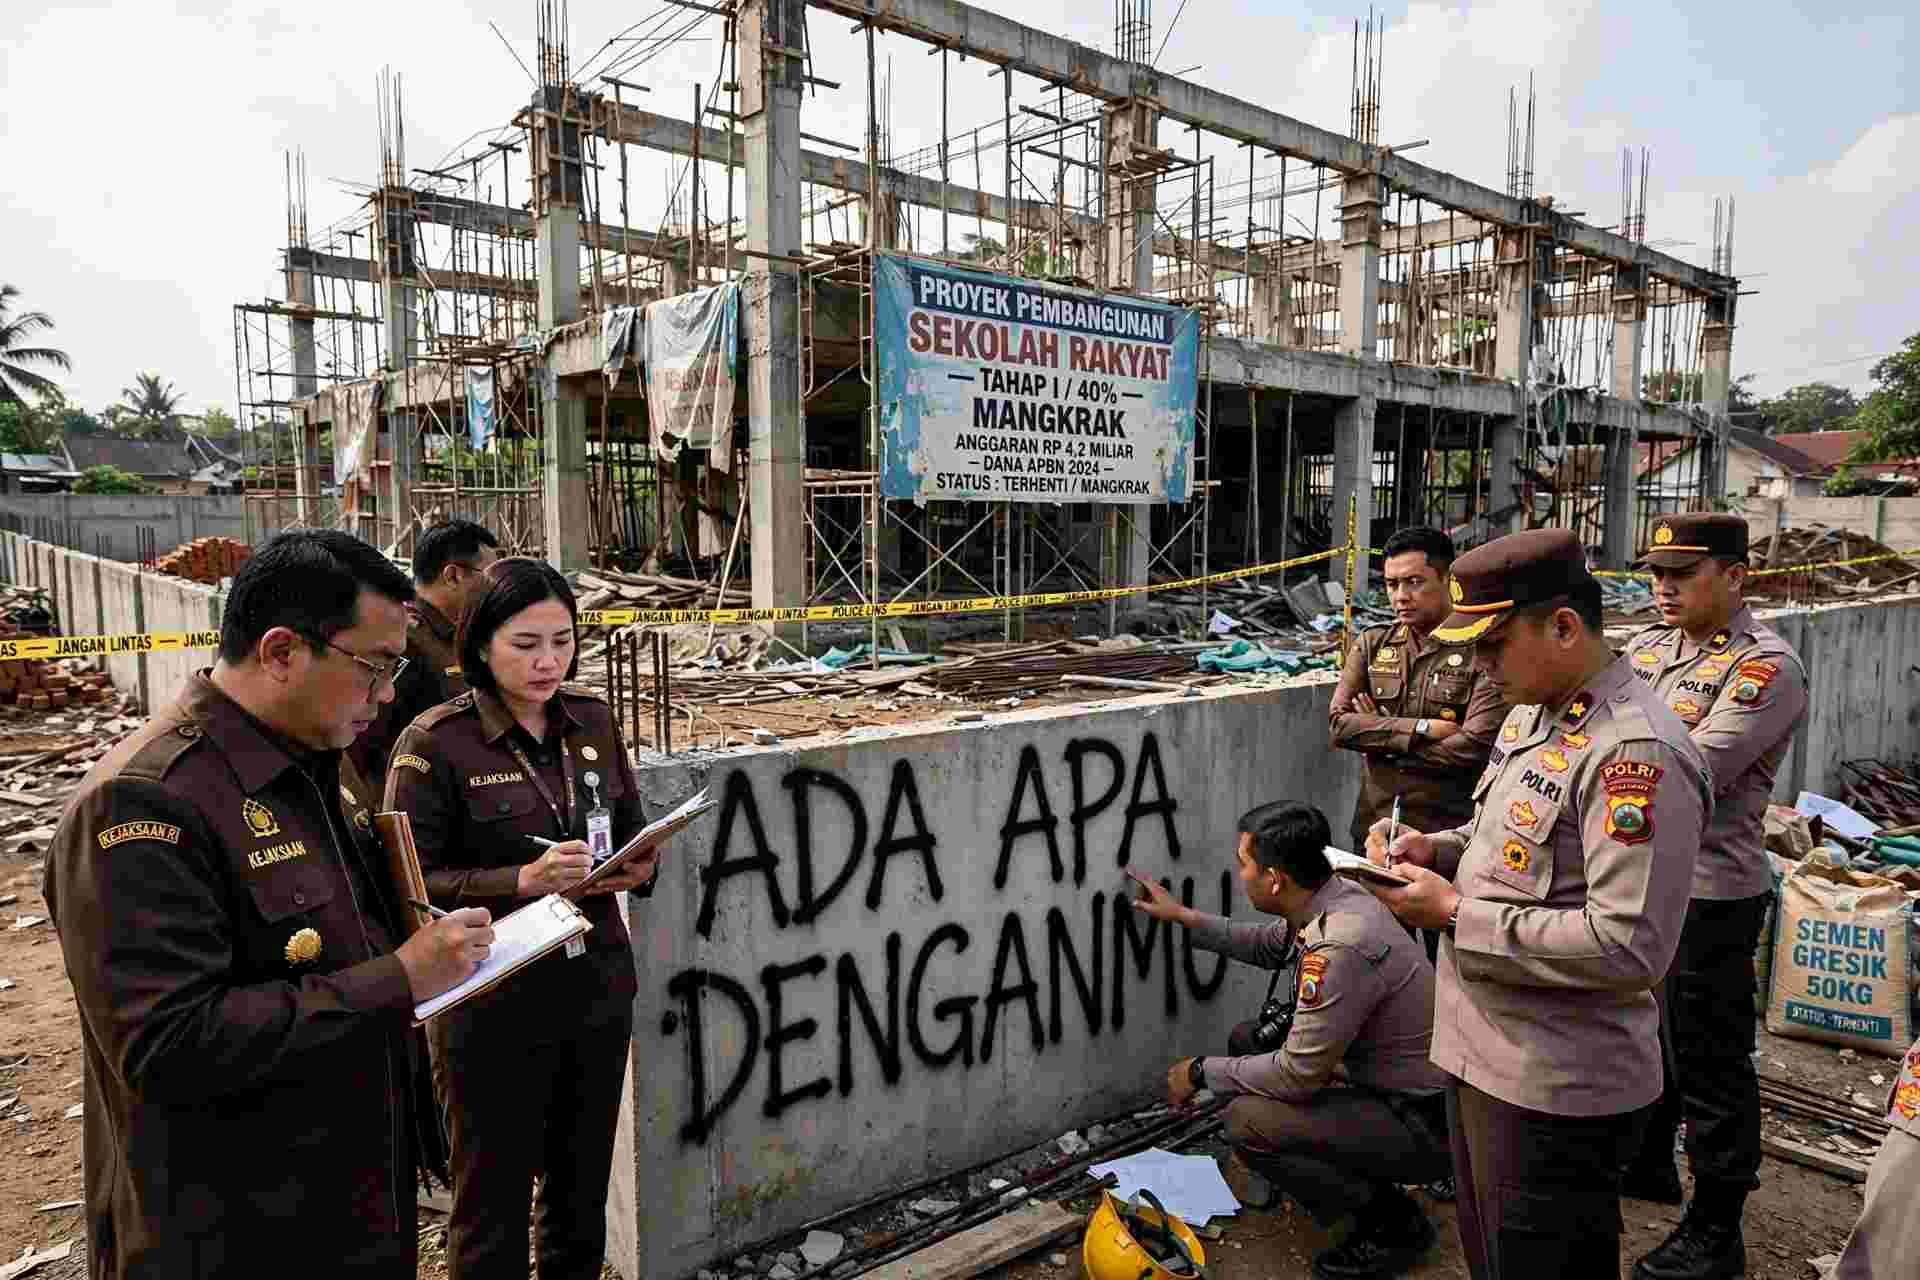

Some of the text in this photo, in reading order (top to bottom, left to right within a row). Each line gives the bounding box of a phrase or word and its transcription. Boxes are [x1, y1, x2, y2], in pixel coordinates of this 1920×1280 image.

[919, 275, 1166, 341] PROYEK PEMBANGUNAN
[909, 311, 1172, 381] SEKOLAH RAKYAT
[979, 367, 1047, 398] TAHAP
[1065, 378, 1072, 399] /
[1078, 380, 1118, 404] 40%
[972, 397, 1127, 439] MANGKRAK
[955, 434, 1134, 460] ANGGARAN RP 4,2 MILIAR
[983, 455, 1100, 476] DANA APBN 2024
[936, 473, 992, 491] STATUS
[1003, 475, 1068, 494] TERHENTI
[1071, 478, 1078, 494] /
[1080, 478, 1150, 495] MANGKRAK
[630, 610, 672, 624] JANGAN
[675, 610, 711, 623] LINTAS
[736, 609, 774, 622] JANGAN
[776, 607, 809, 620] LINTAS
[832, 605, 864, 617] POLICE
[55, 638, 106, 655] JANGAN
[109, 634, 152, 652] LINTAS
[470, 772, 523, 787] KEJAKSAAN
[1604, 763, 1655, 778] POLRI
[1519, 769, 1562, 803] POLRI
[100, 822, 165, 847] KEJAKSAAN
[695, 731, 1181, 937] ADA APA
[247, 840, 307, 870] KEJAKSAAN
[1796, 917, 1886, 952] SEMEN
[1792, 943, 1889, 981] GRESIK
[1807, 975, 1873, 1005] 50KG
[664, 869, 1232, 1146] DENGANMU
